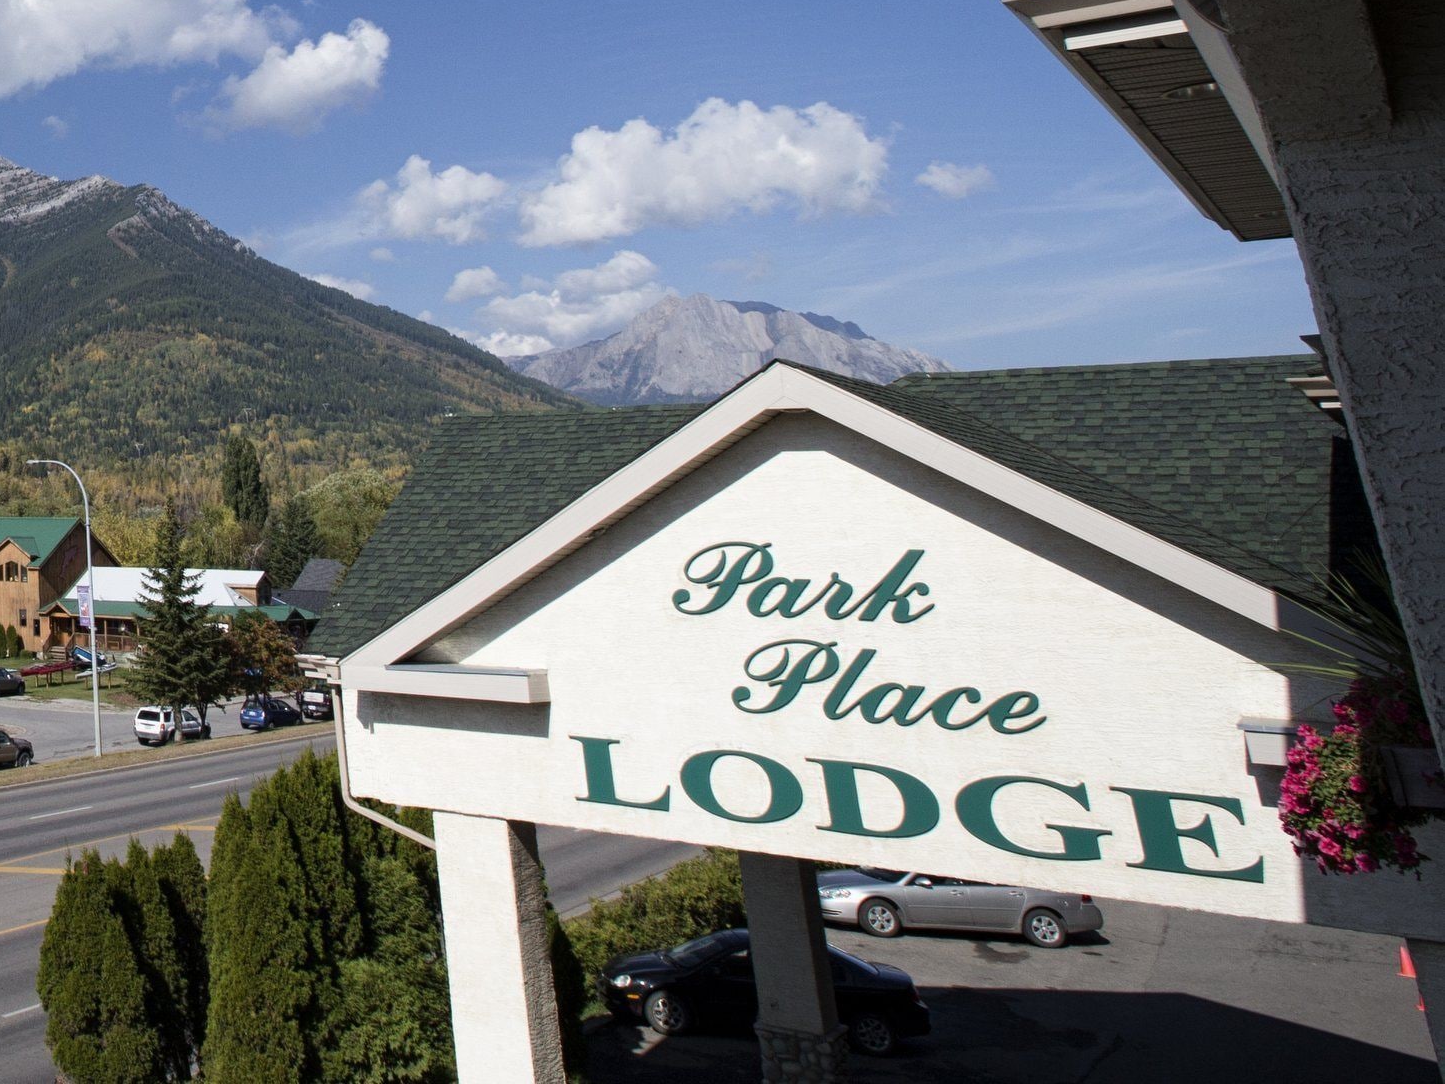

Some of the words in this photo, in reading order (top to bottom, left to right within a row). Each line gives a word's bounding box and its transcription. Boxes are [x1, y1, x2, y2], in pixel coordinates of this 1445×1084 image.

[672, 541, 935, 623] Park
[731, 639, 1046, 734] Place
[567, 734, 1265, 884] LODGE
